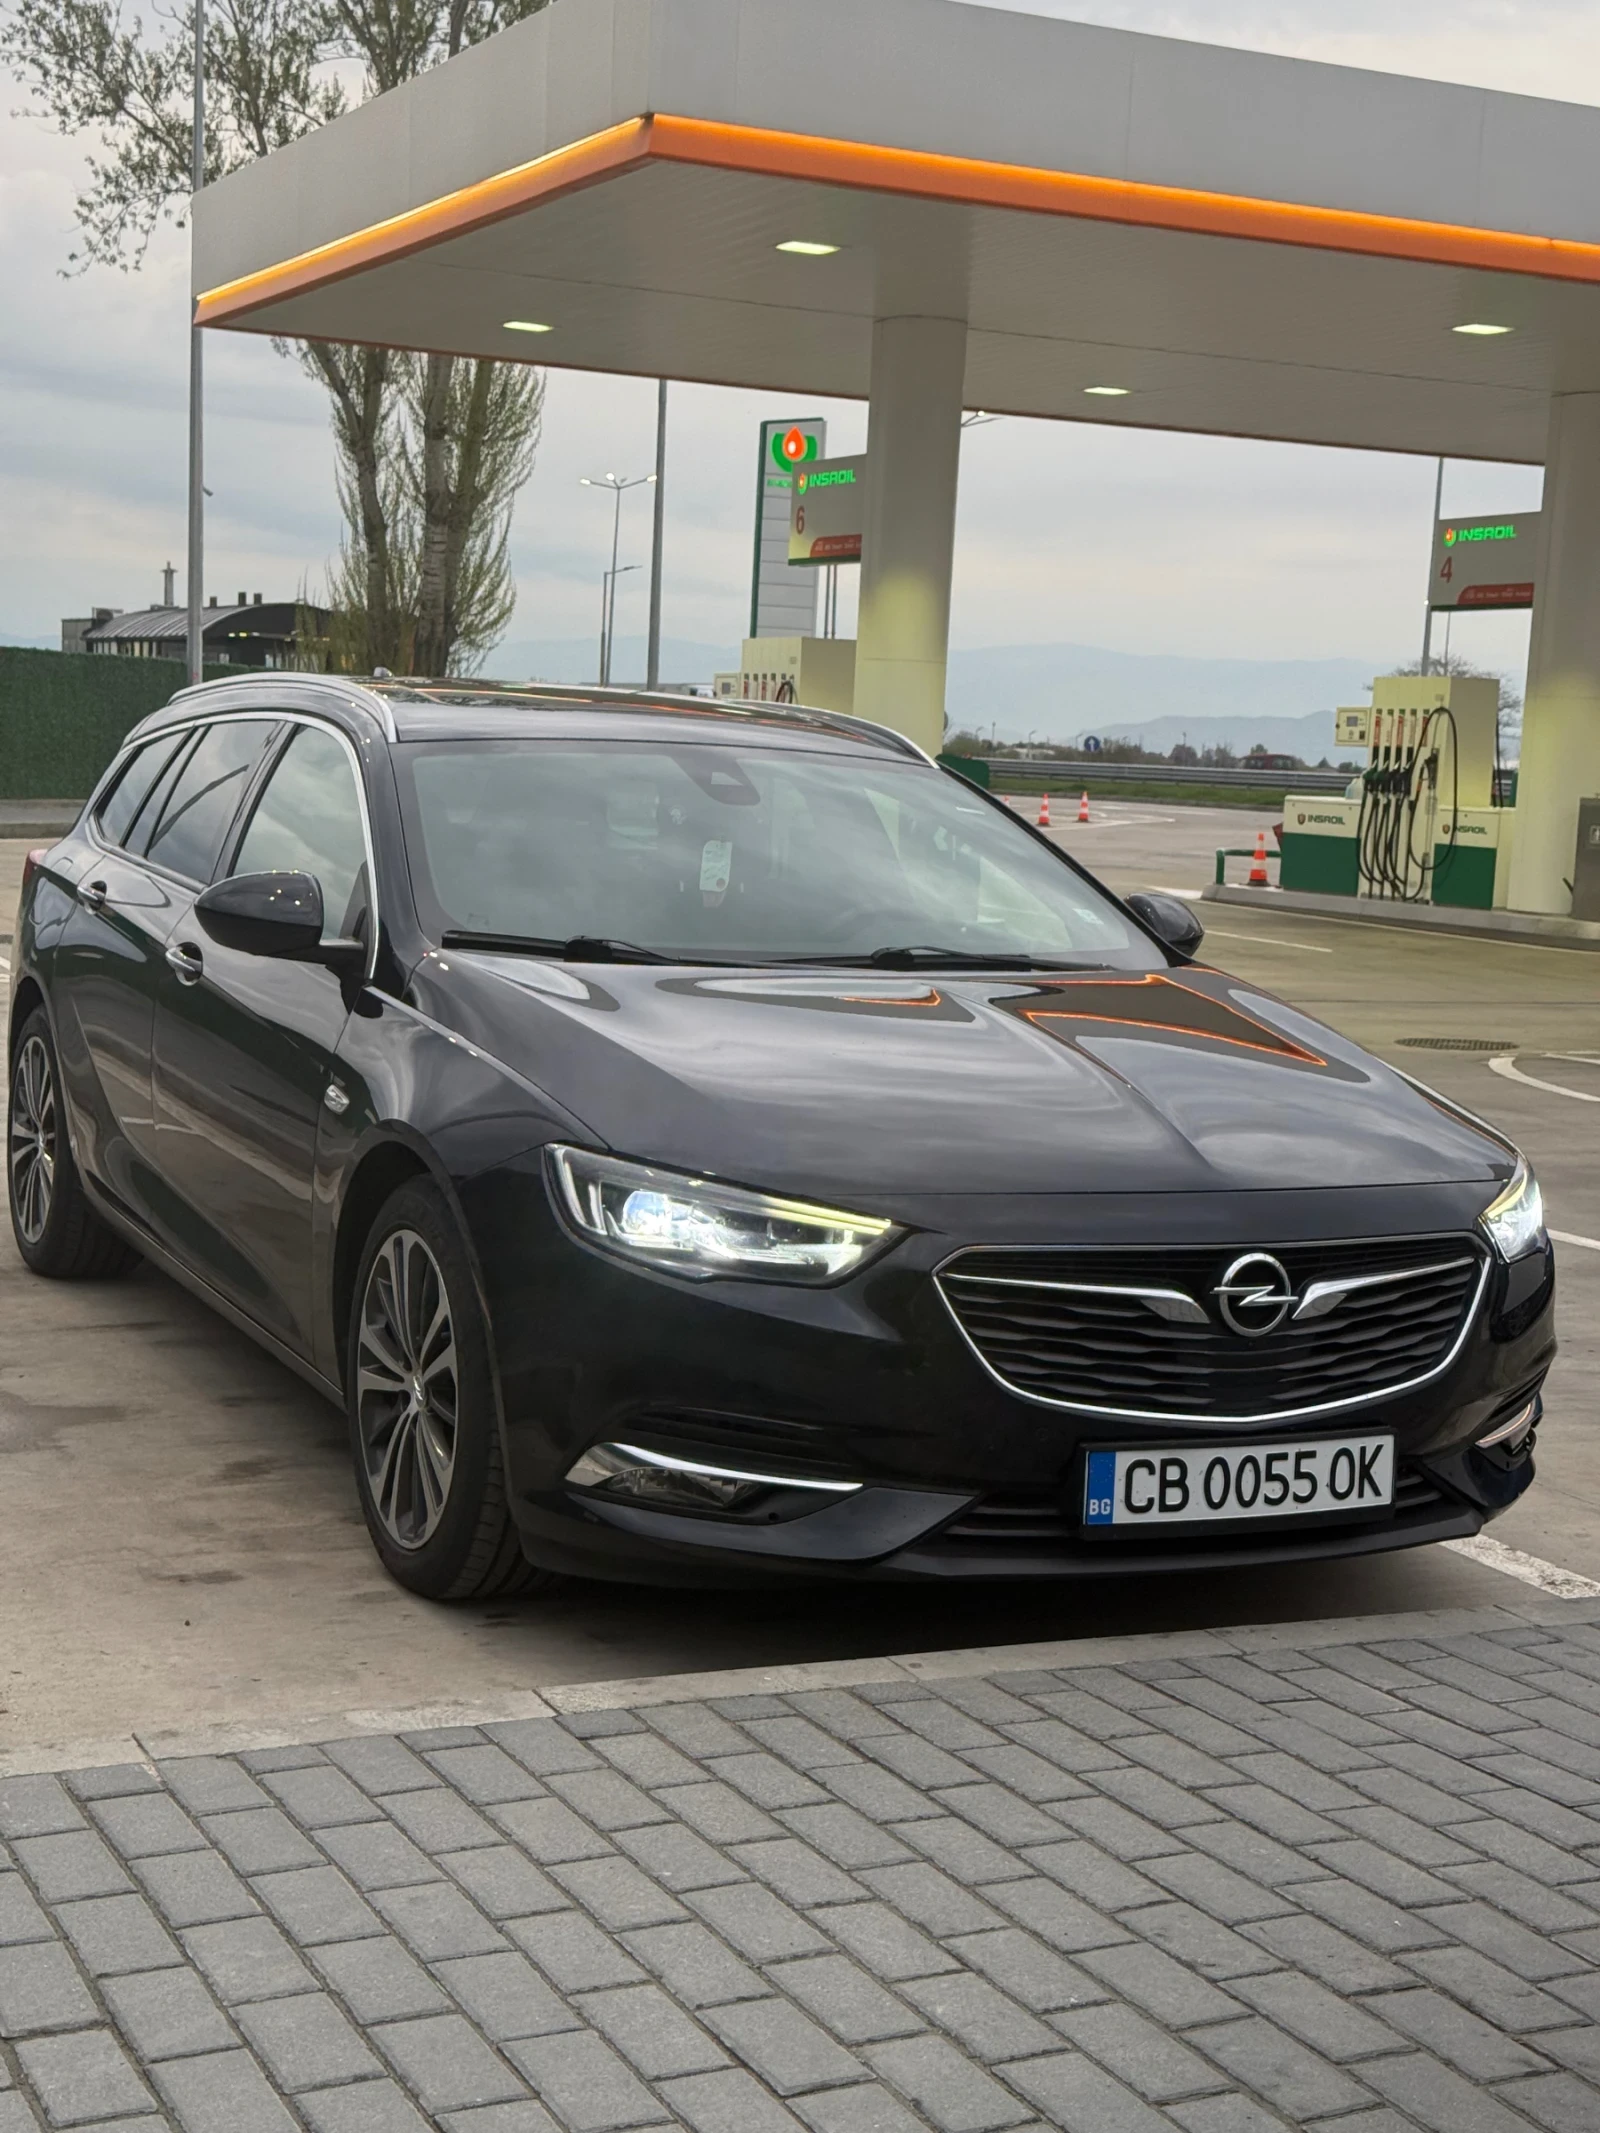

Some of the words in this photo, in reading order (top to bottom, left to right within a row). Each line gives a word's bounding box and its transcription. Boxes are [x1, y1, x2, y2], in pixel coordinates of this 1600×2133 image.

[809, 469, 856, 487] INSAOIL
[795, 505, 805, 535] 6
[1459, 525, 1516, 542] INSAOIL
[1440, 556, 1452, 583] 4
[1124, 1456, 1190, 1514] CB
[1203, 1450, 1318, 1510] 0055
[1329, 1443, 1385, 1501] OK
[1089, 1498, 1111, 1515] BG
